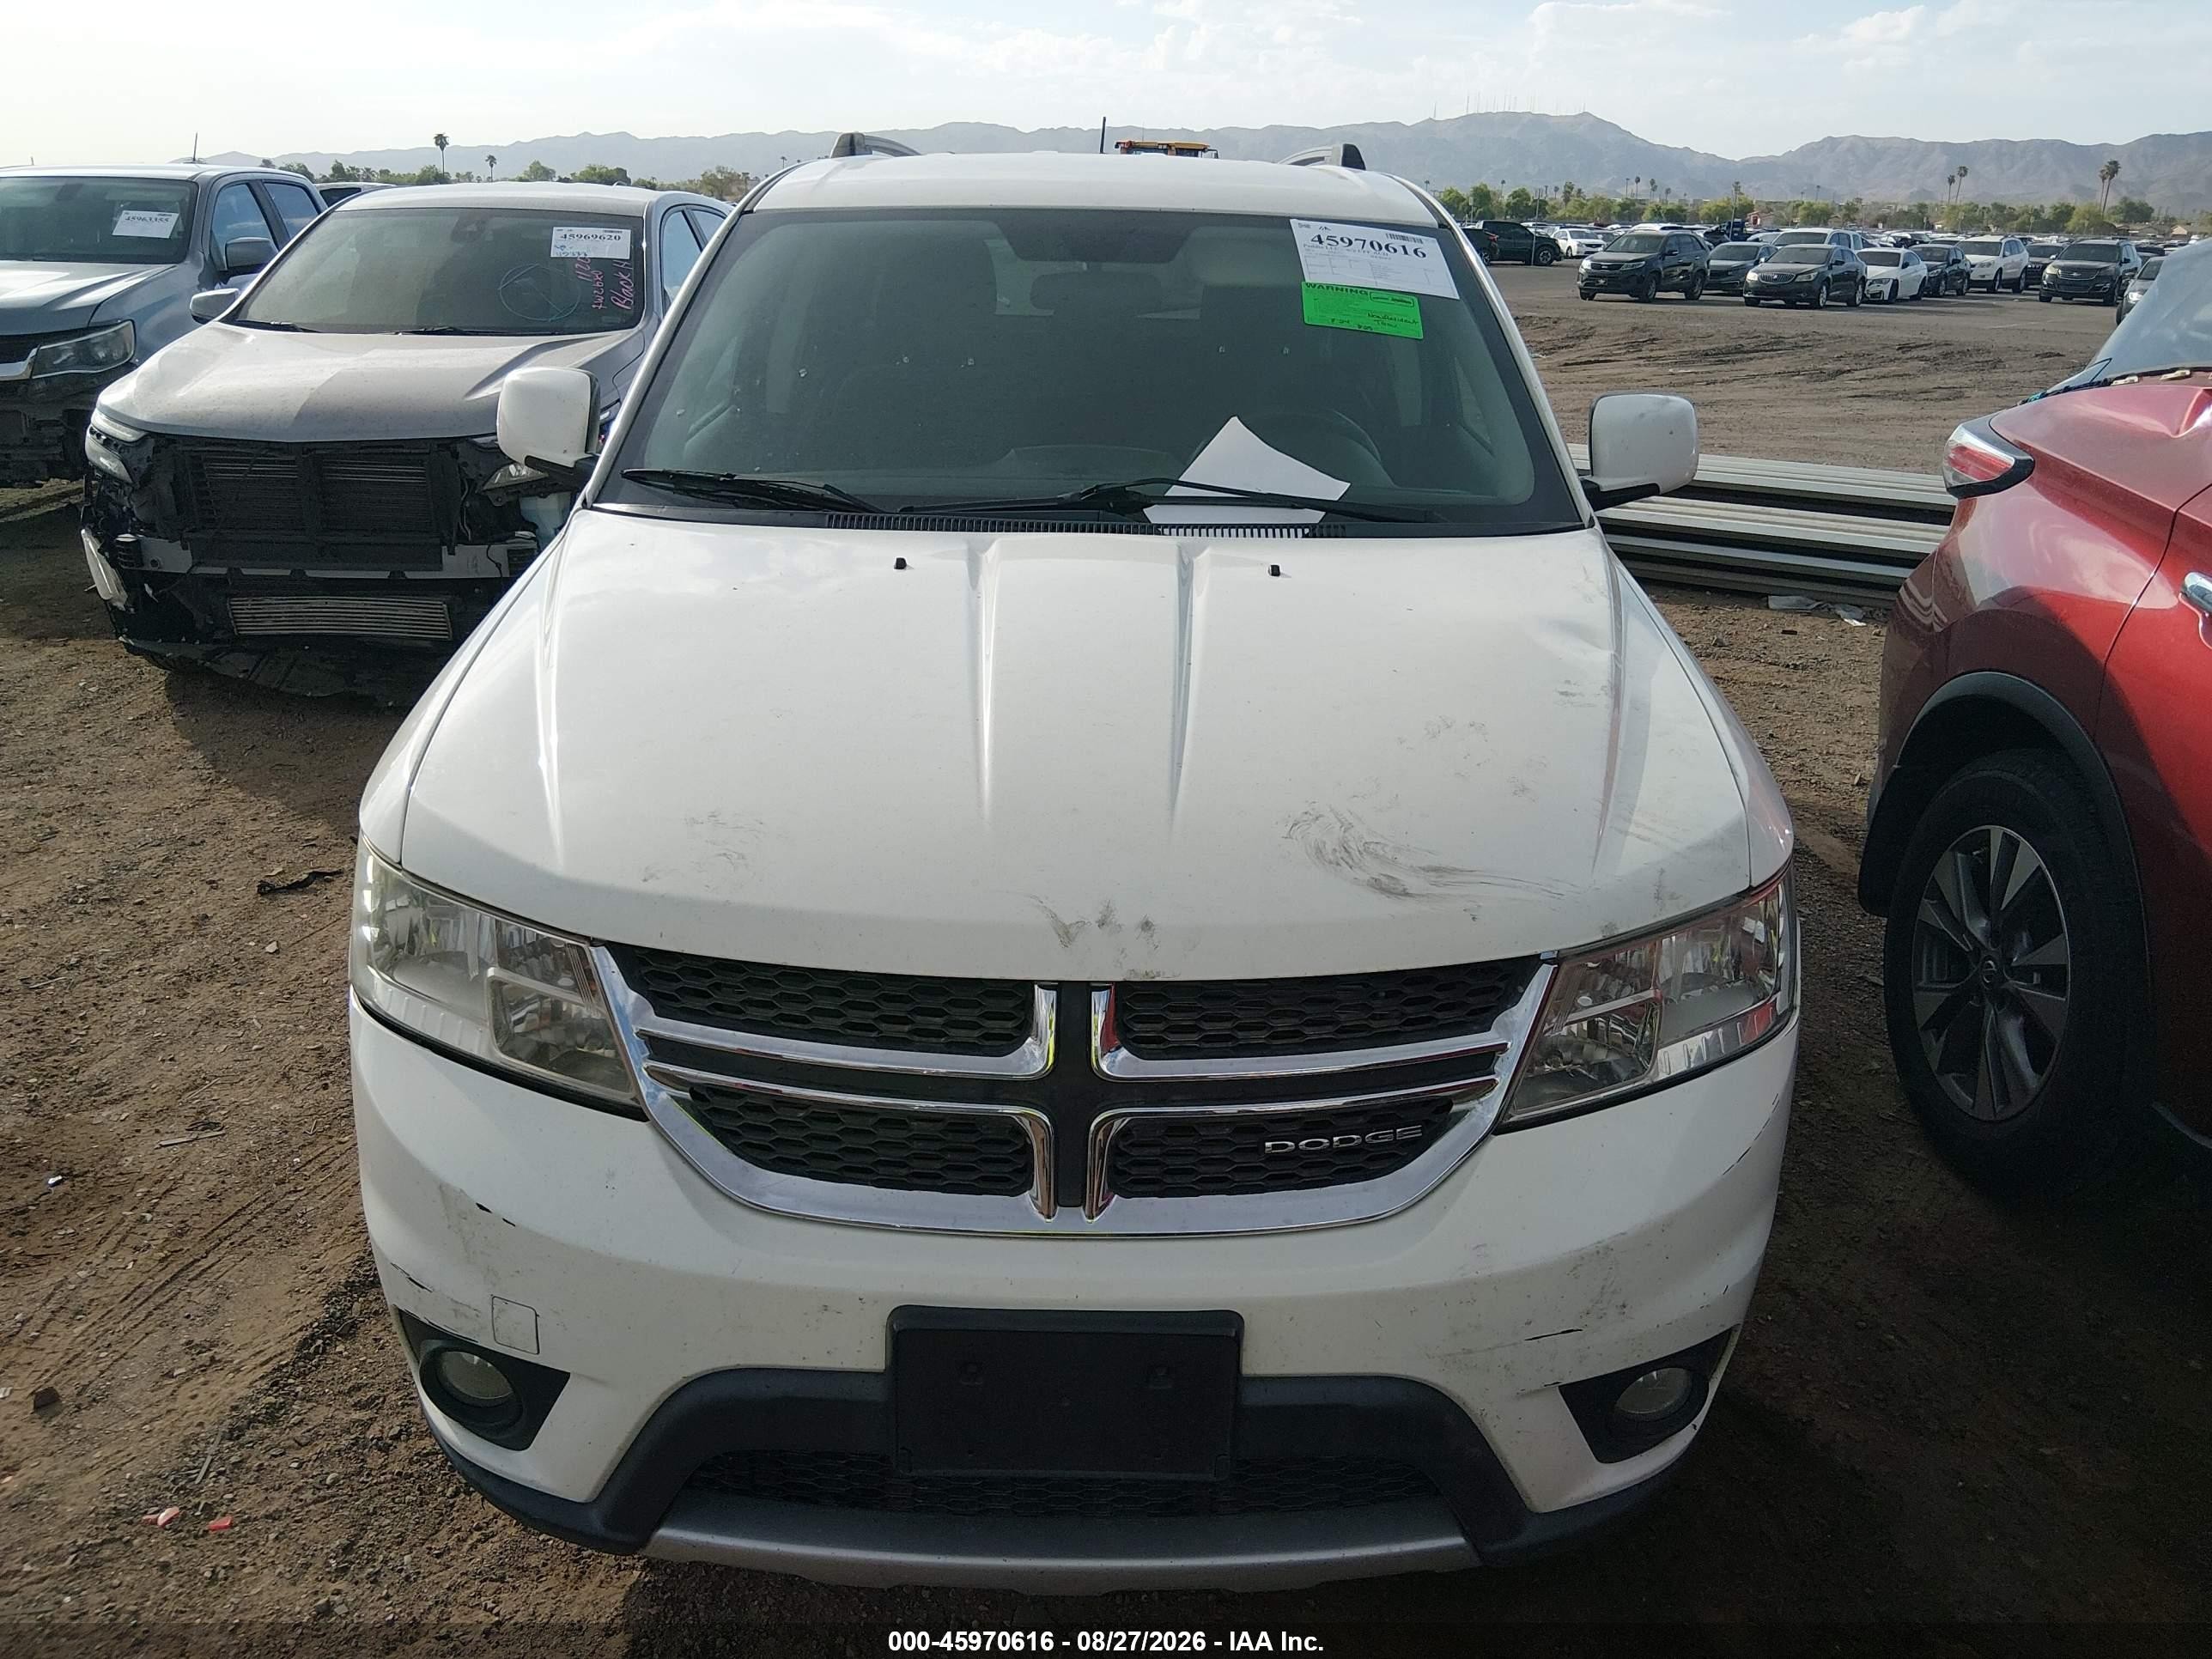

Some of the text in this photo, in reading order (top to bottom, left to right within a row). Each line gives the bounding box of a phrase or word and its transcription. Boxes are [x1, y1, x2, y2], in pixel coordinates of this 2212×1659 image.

[1310, 234, 1426, 258] 45970616
[1305, 283, 1369, 296] WARNING
[1264, 1125, 1423, 1154] DODGE
